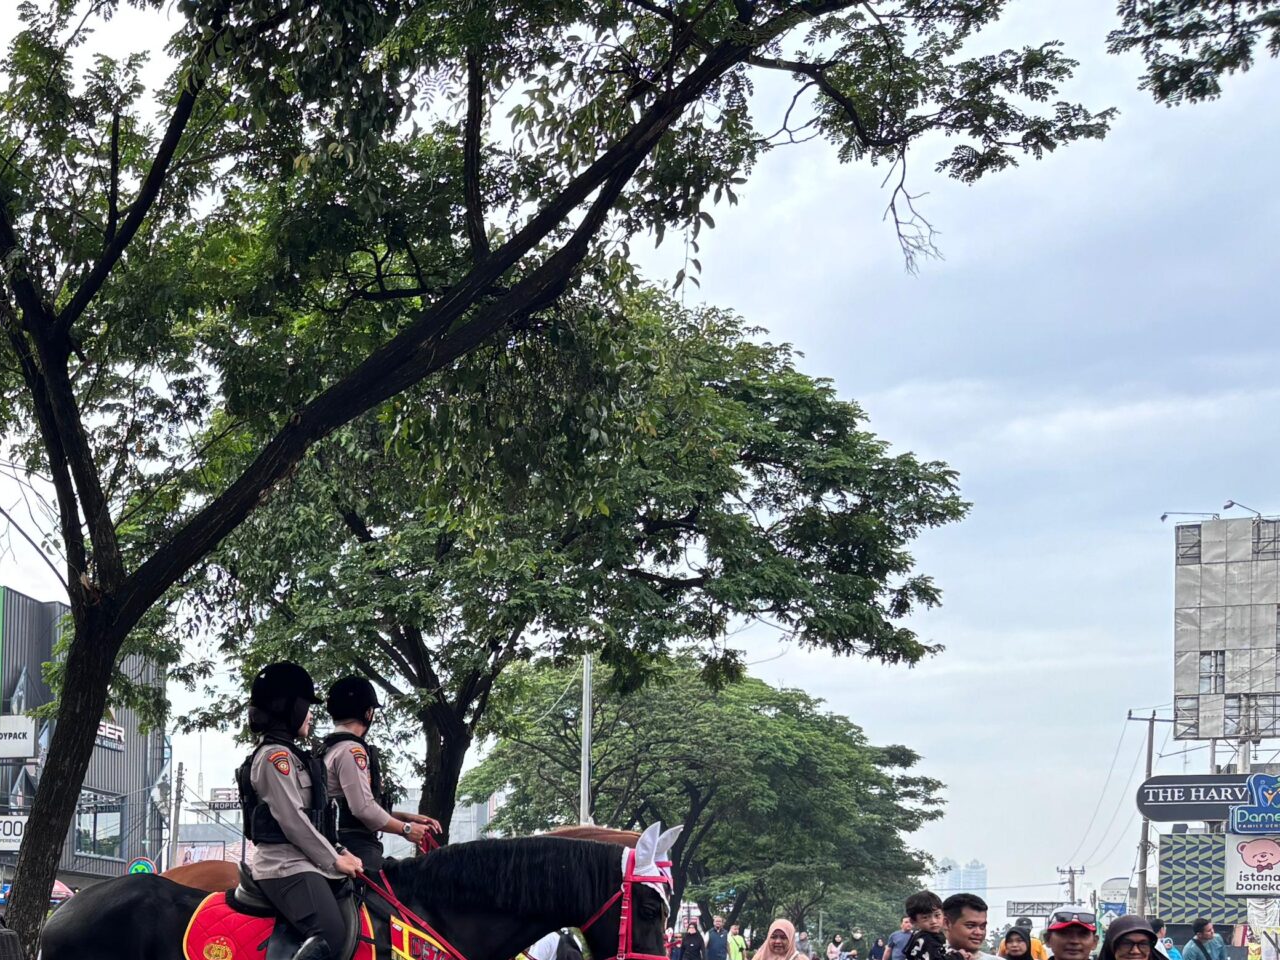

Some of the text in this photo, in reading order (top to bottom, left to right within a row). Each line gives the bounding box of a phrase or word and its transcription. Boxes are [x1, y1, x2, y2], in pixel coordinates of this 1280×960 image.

[96, 720, 125, 742] GER
[1144, 787, 1247, 802] THE HARV
[1237, 809, 1280, 823] Dame
